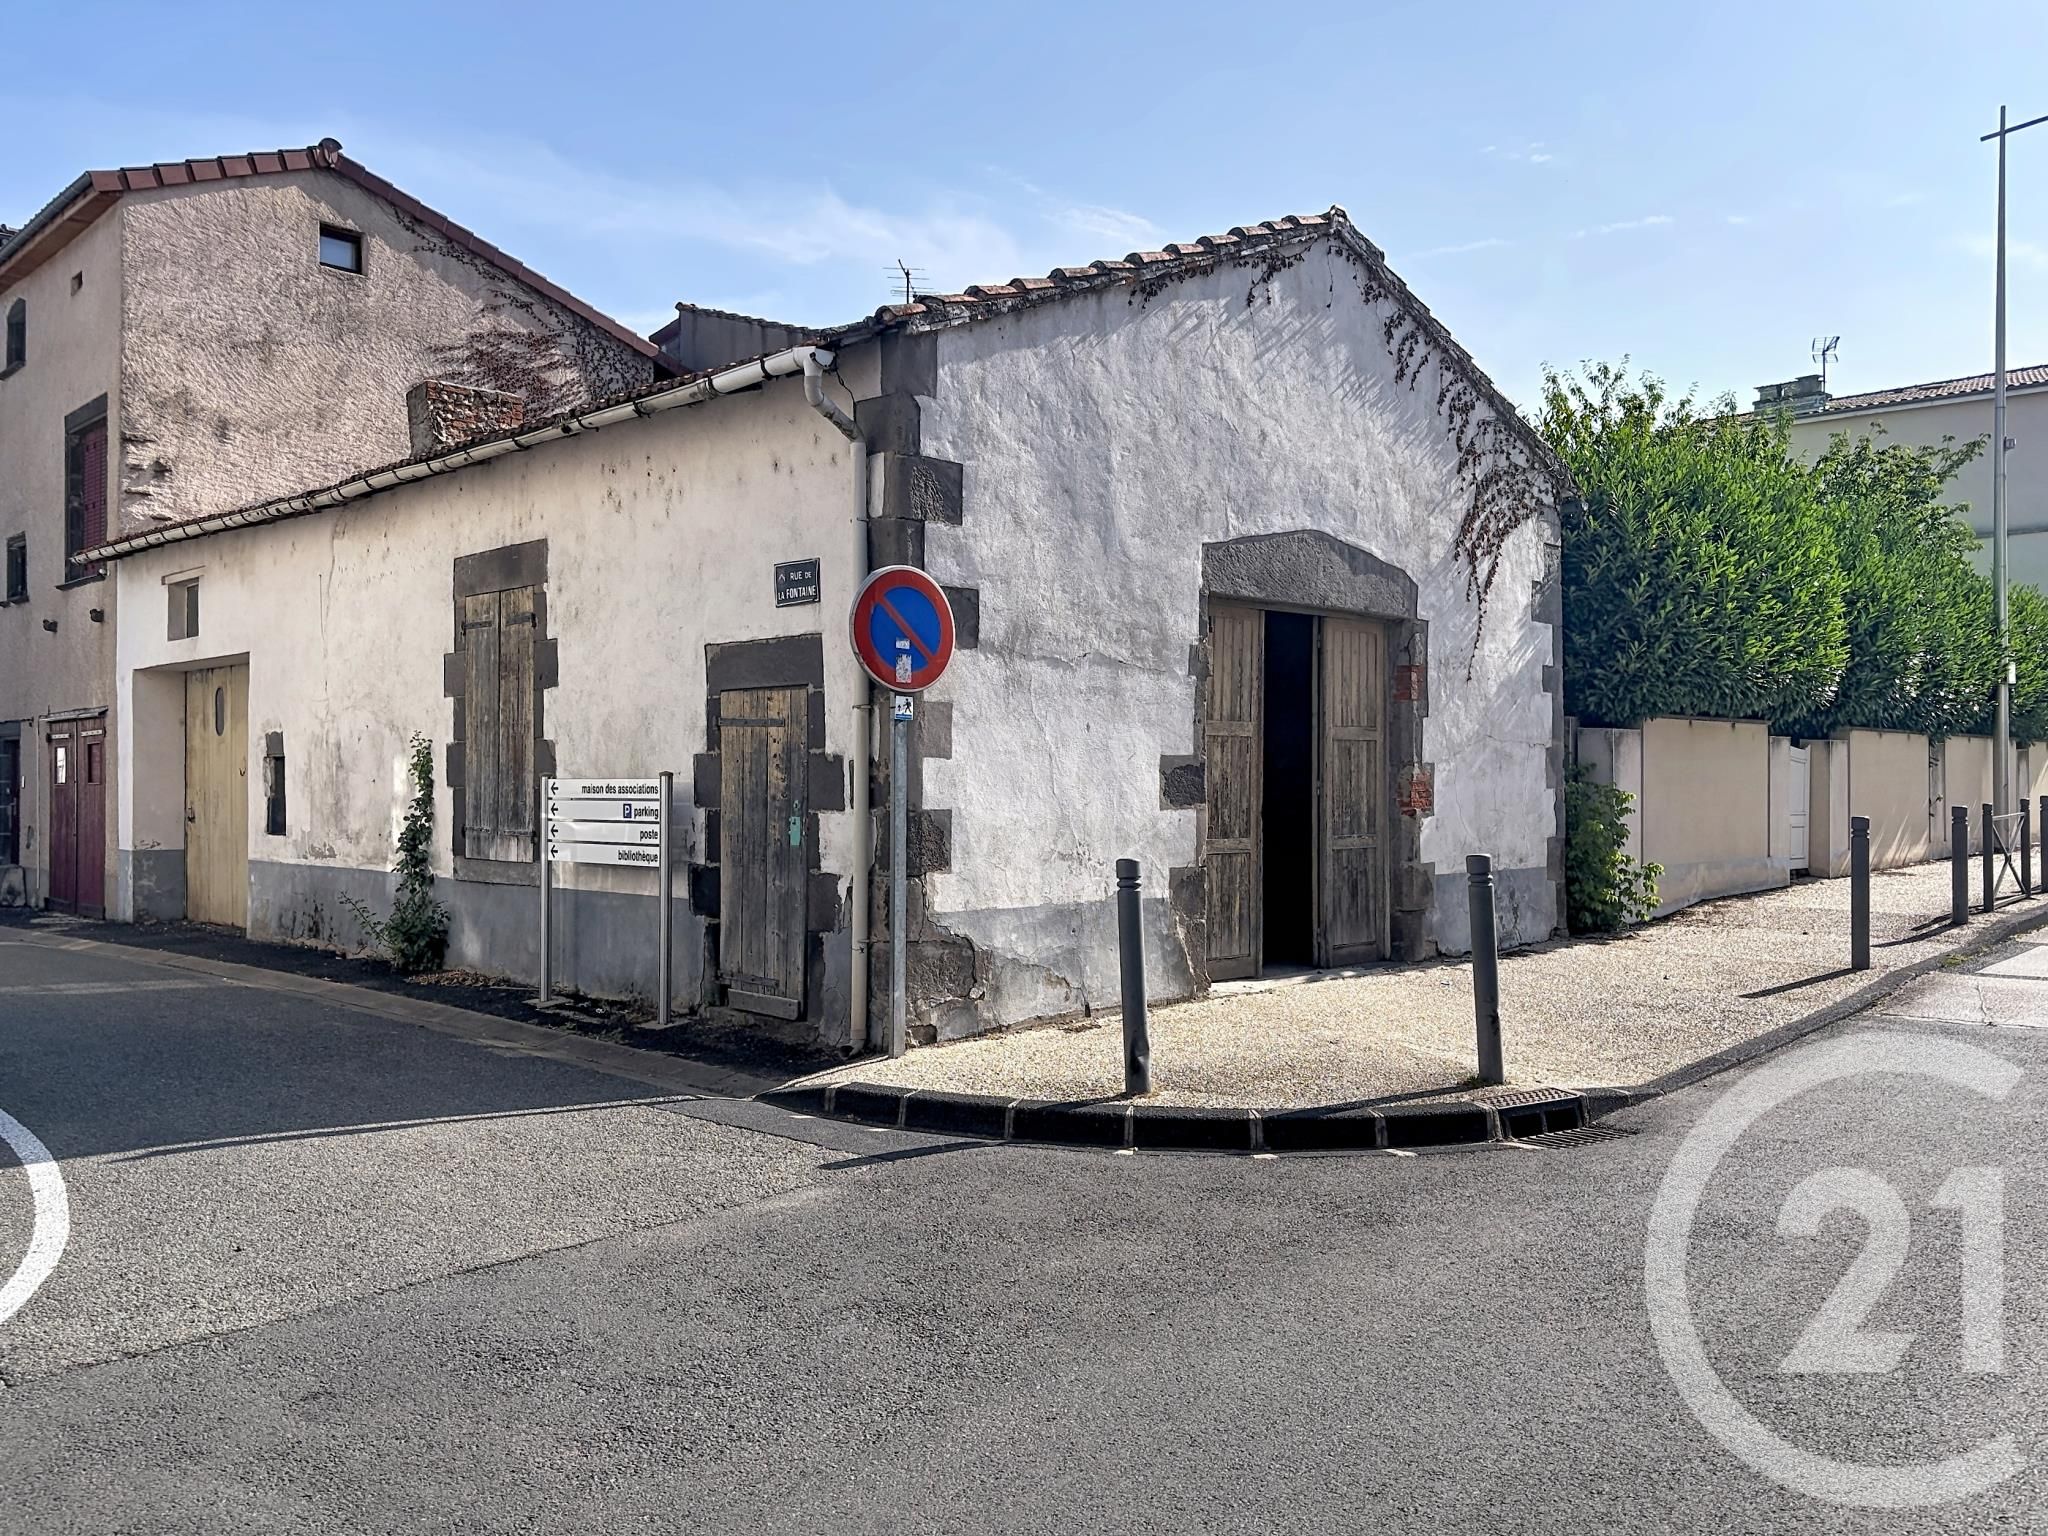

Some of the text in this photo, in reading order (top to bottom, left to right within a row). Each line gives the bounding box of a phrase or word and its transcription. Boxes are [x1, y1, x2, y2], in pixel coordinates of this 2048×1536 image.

[790, 571, 812, 580] RUE DE
[778, 585, 816, 600] LA FONTAINE
[581, 784, 659, 795] maison des associations
[633, 806, 659, 819] parking
[639, 829, 659, 841] poste
[617, 849, 659, 864] bibliothèque
